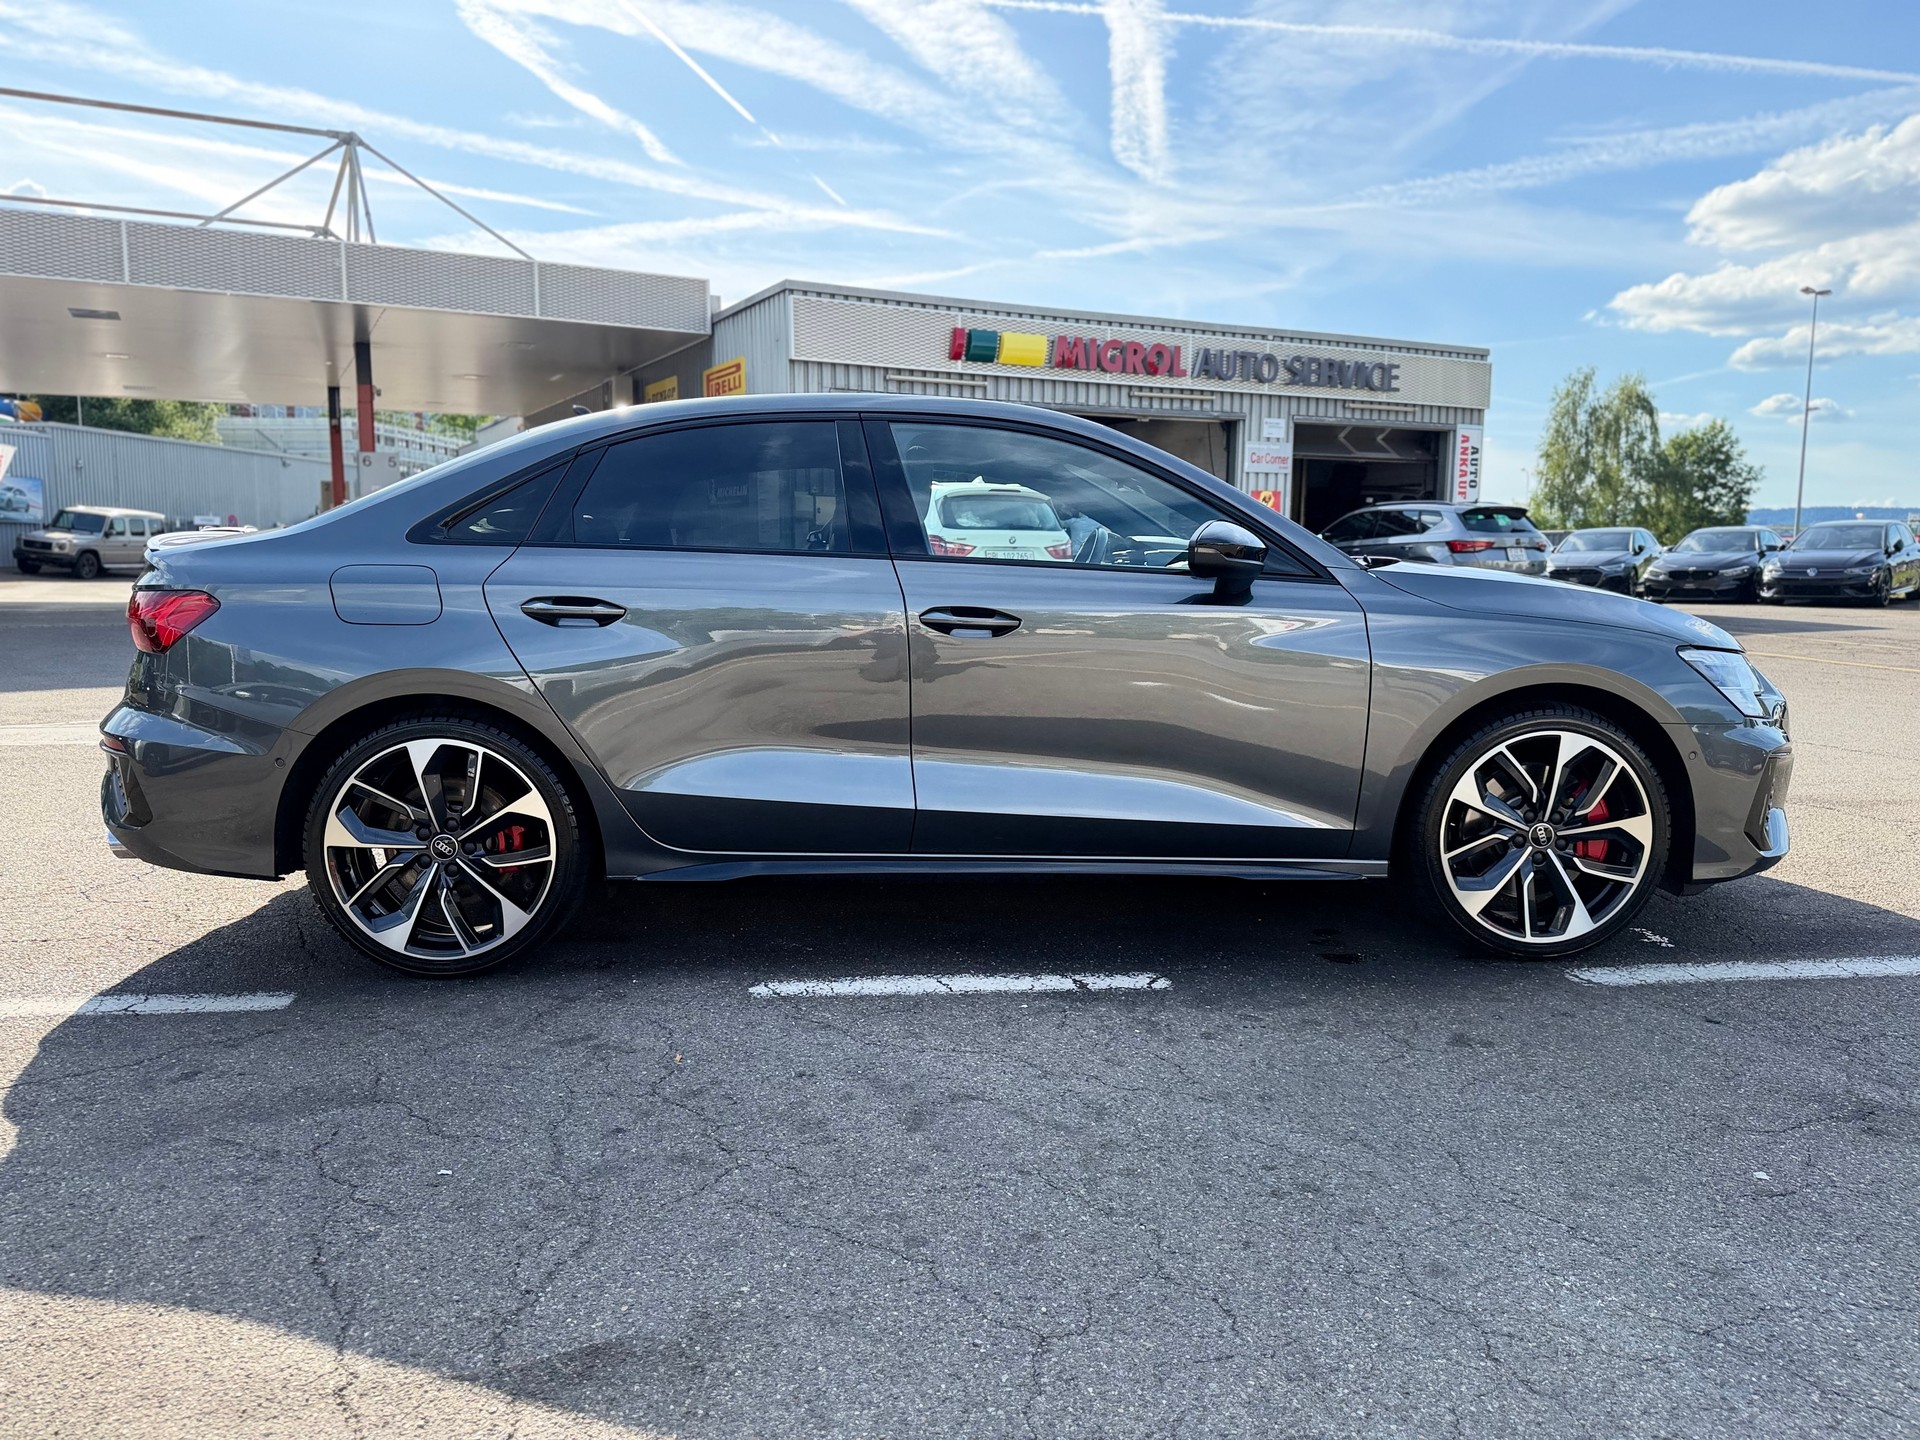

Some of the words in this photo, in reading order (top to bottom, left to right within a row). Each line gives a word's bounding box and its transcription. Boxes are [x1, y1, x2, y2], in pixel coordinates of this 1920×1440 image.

[705, 362, 742, 397] PIRELLI
[1053, 335, 1188, 377] MIGROL
[1192, 348, 1279, 383] AUTO
[1285, 355, 1400, 392] SERVICE
[362, 455, 372, 467] 6
[388, 456, 397, 468] 5
[1458, 434, 1470, 500] ANKAUF
[1469, 446, 1479, 489] AUTO
